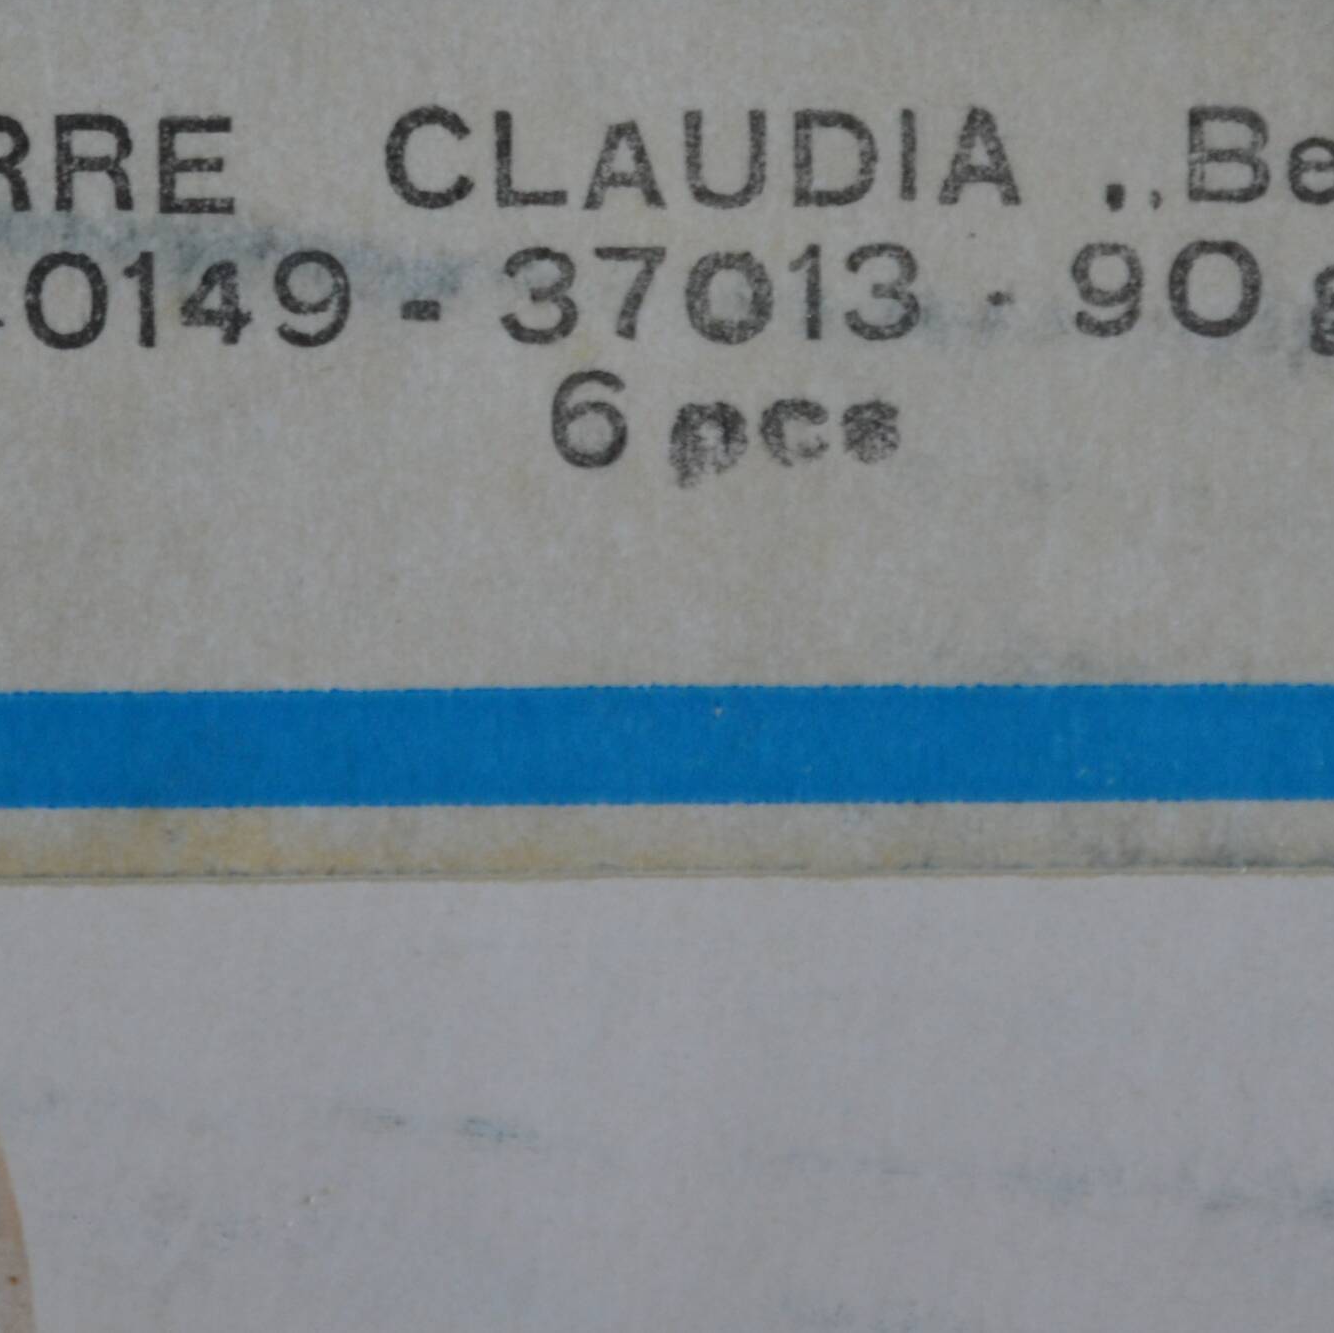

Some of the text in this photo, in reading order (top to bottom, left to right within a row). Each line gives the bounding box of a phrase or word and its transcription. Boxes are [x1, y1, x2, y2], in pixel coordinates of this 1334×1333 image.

[382, 104, 1023, 211] CLAUDIA
[1069, 238, 1265, 339] 90
[551, 369, 628, 469] 6
